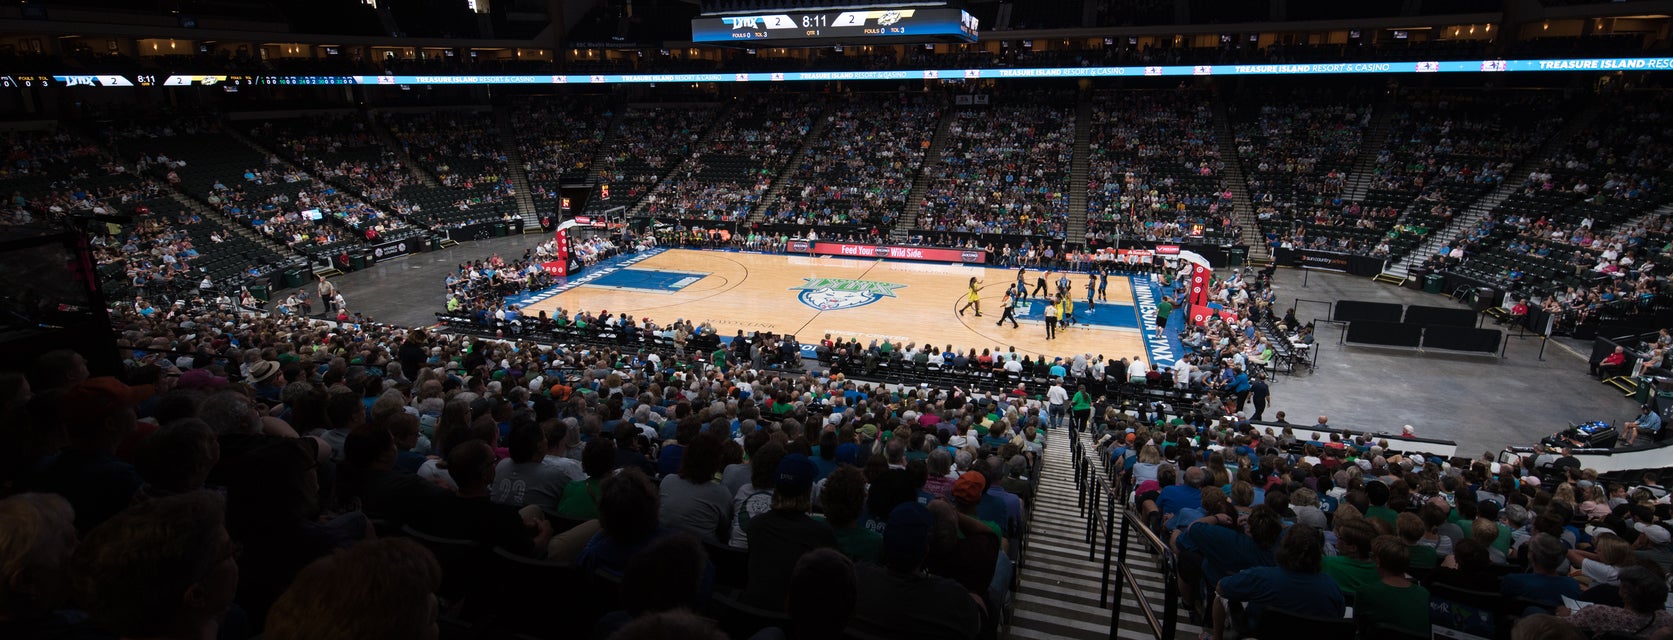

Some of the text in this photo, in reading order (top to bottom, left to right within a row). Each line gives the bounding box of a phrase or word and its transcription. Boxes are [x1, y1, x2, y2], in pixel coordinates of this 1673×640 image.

[775, 17, 781, 26] 2
[802, 15, 827, 27] 8:11
[849, 15, 855, 24] 2
[1235, 65, 1277, 73] TREASURE
[1278, 64, 1310, 73] ISLAND
[1312, 64, 1345, 72] RESORT
[1354, 63, 1390, 71] CASINO
[1539, 60, 1599, 69] TREASURE
[1600, 60, 1646, 69] ISLAND
[1063, 68, 1090, 76] RESORT
[1097, 67, 1125, 75] CASINO
[111, 77, 118, 85] 2
[137, 75, 156, 83] 8:11
[841, 245, 857, 255] Feed
[857, 245, 874, 256] Your
[890, 247, 906, 257] Wild
[520, 267, 619, 304] MINNESOTA
[788, 278, 908, 298] LYNX
[1147, 334, 1175, 362] LYNX
